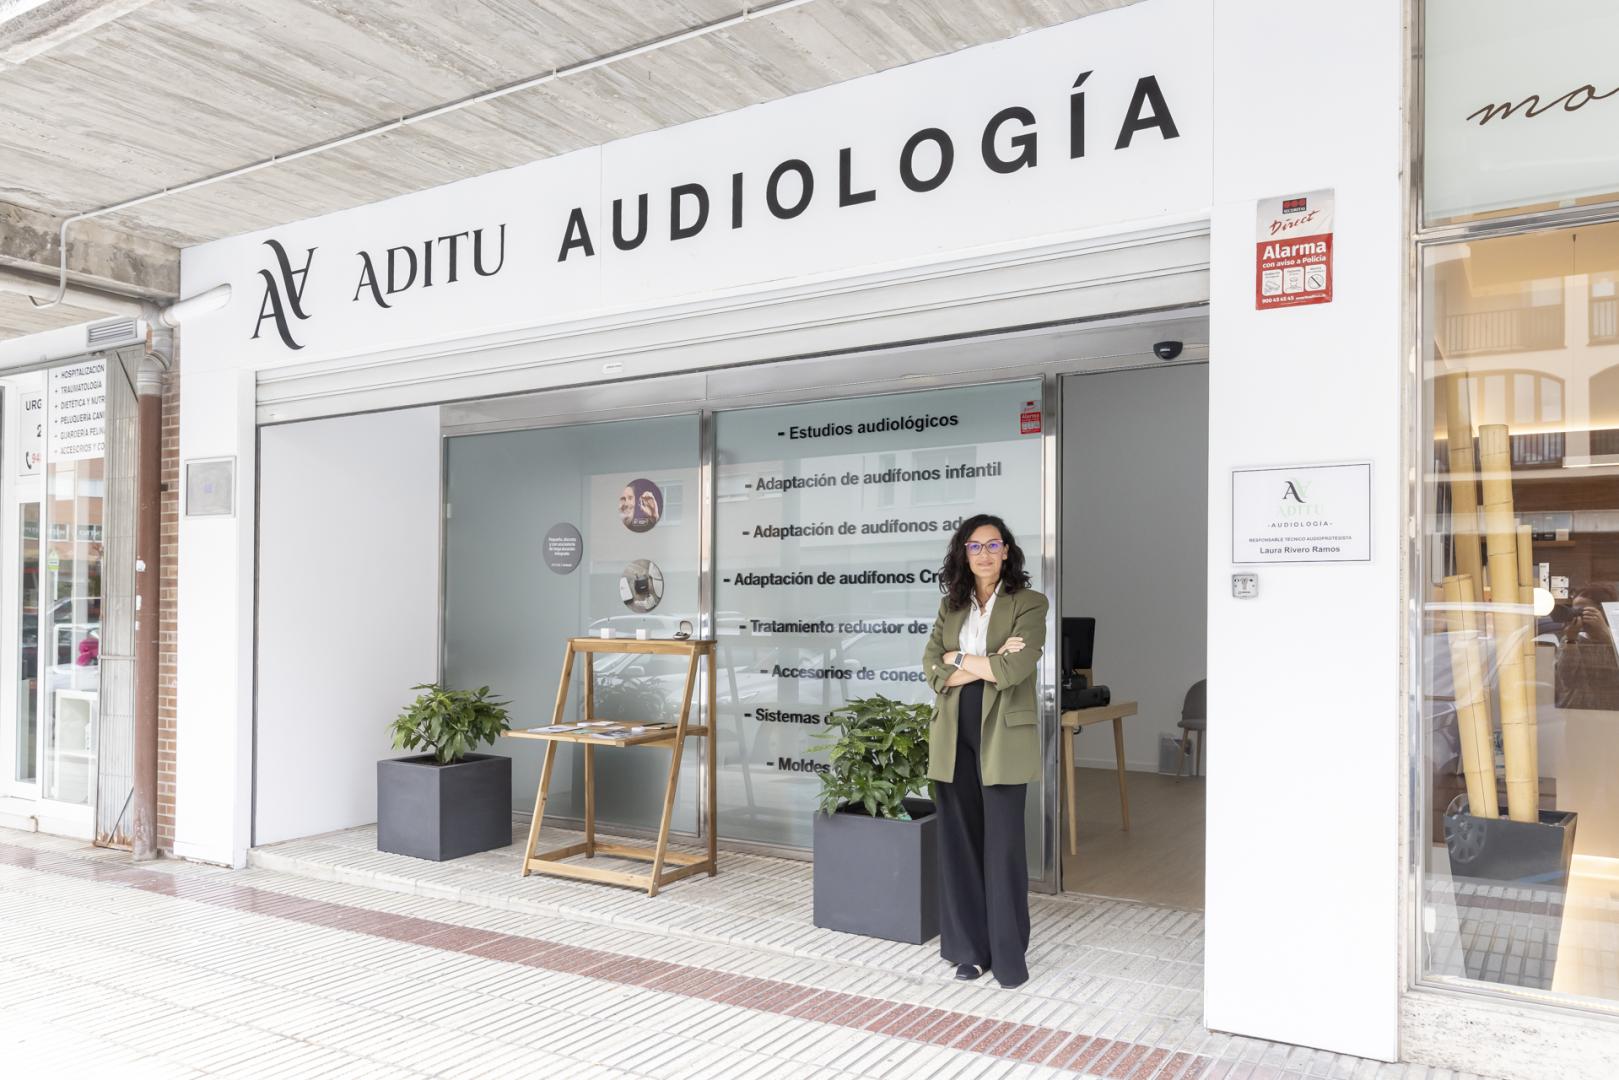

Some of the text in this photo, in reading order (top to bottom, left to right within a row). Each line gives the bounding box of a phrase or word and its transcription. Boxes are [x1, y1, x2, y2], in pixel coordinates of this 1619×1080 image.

[1466, 84, 1619, 126] mo
[557, 70, 1181, 263] AUDIOLOGÍA
[1269, 210, 1320, 235] Direct
[1262, 242, 1326, 260] Alarma
[352, 223, 507, 309] ADITU
[1276, 259, 1295, 267] aviso
[25, 398, 42, 411] URG
[91, 395, 105, 405] NUTR
[789, 423, 853, 440] Estudios
[857, 414, 958, 438] audiológicos
[756, 473, 836, 492] Adaptación
[840, 471, 859, 486] de
[863, 466, 940, 485] audífonos
[945, 461, 1002, 480] infantil
[753, 522, 834, 541] Adaptación
[838, 520, 857, 536] de
[861, 517, 938, 535] audífonos
[942, 516, 963, 532] ad
[1260, 545, 1341, 555] Laura Rivero Ramos
[734, 570, 813, 589] Adaptación
[816, 570, 836, 586] de
[839, 567, 915, 586] audífonos
[919, 568, 939, 584] Cr
[750, 619, 834, 634] Tratamiento
[838, 620, 904, 635] reductor
[907, 620, 928, 634] de
[772, 664, 852, 681] Accesorios
[856, 667, 875, 681] de
[880, 671, 927, 683] conec
[755, 708, 820, 726] Sistemas
[778, 756, 831, 774] Moldes
